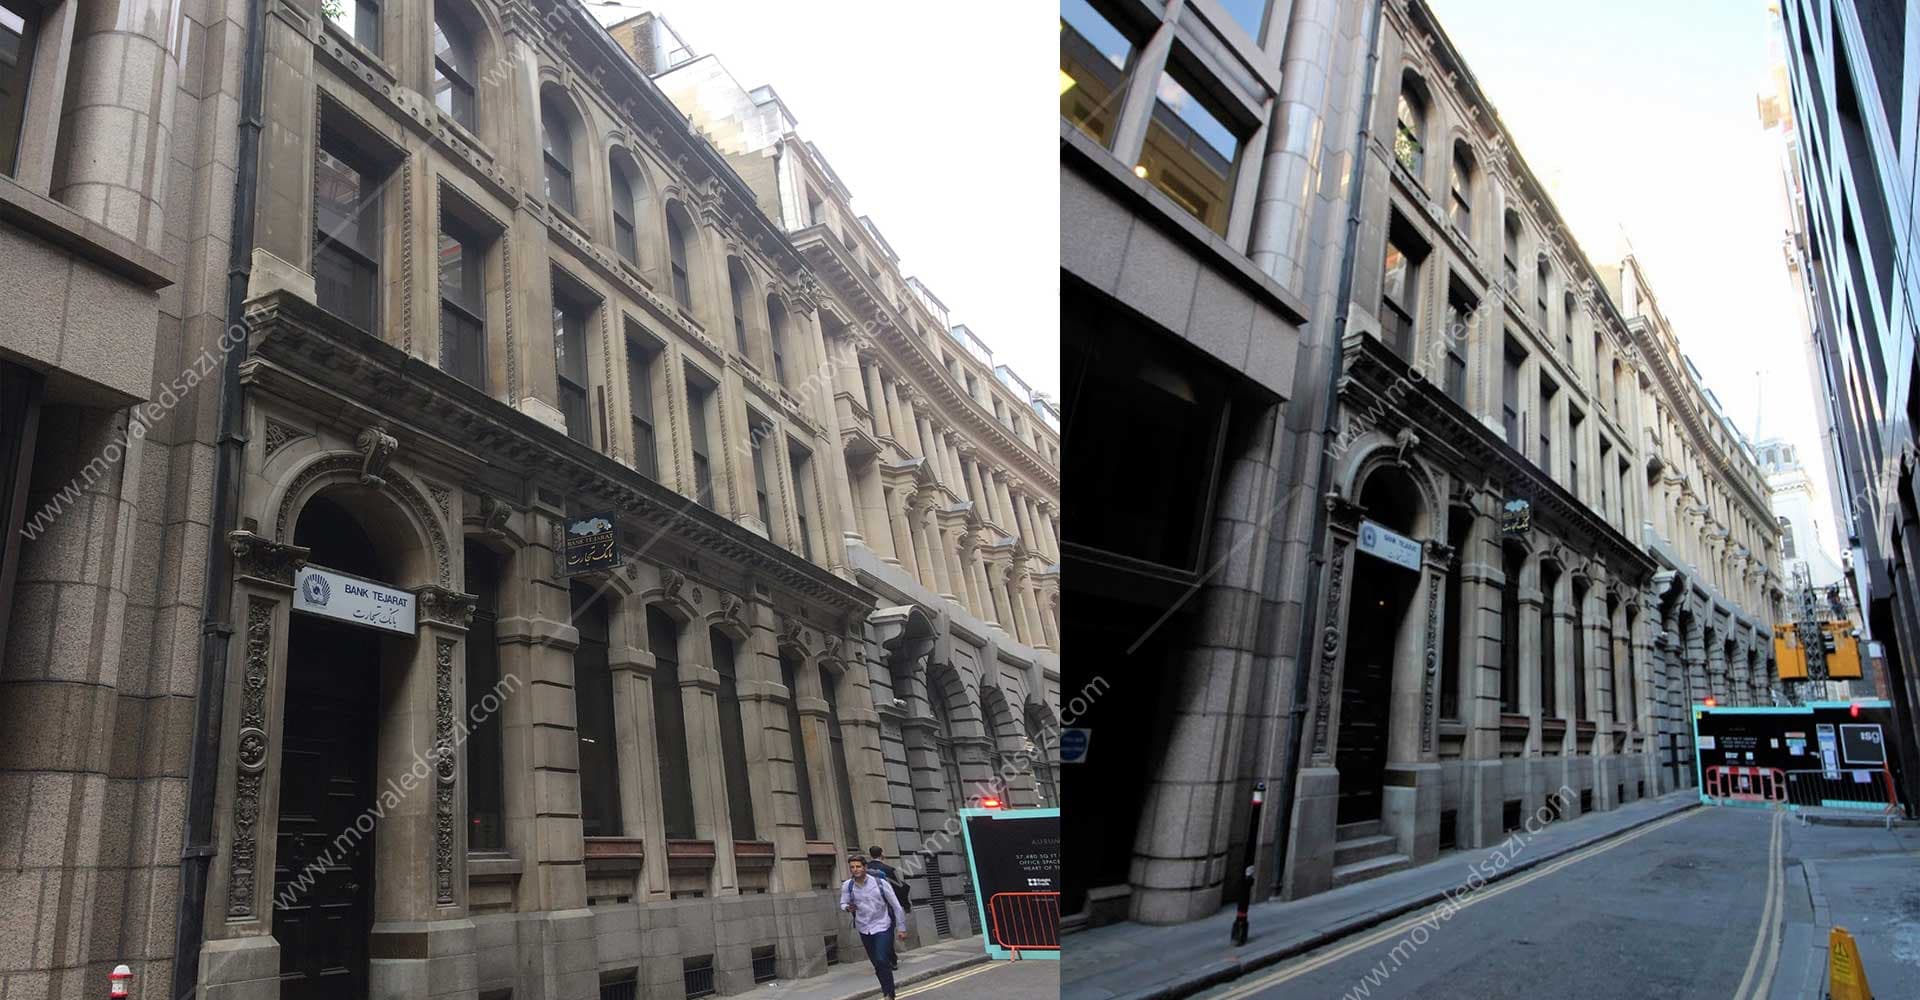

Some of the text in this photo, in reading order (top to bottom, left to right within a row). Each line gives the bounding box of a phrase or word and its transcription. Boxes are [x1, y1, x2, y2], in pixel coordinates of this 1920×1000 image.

[345, 584, 408, 607] BANK TEJARAT
[353, 606, 399, 628] بانک تجارت
